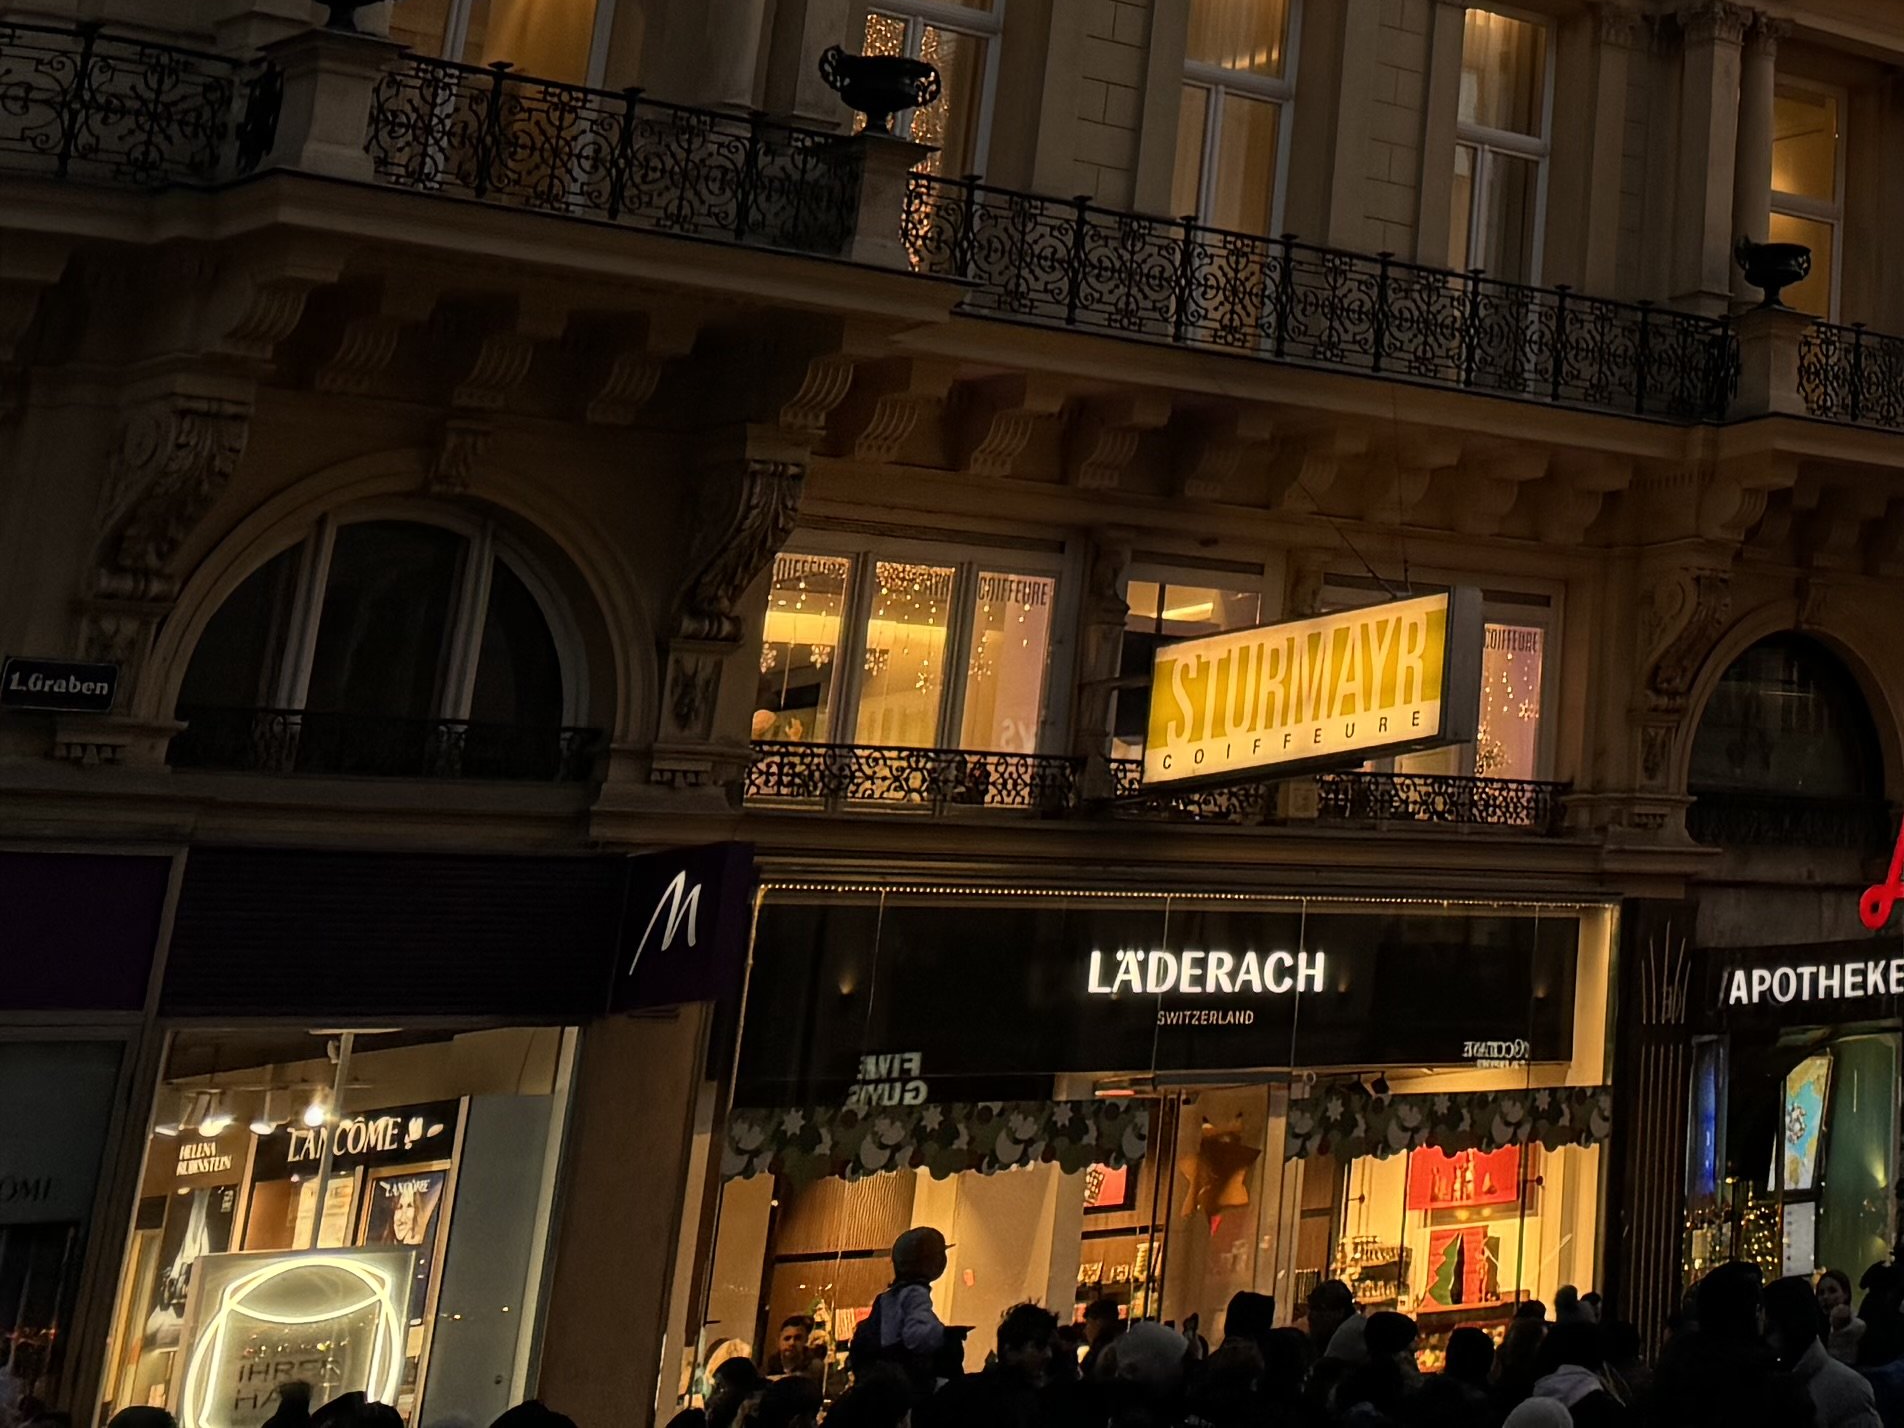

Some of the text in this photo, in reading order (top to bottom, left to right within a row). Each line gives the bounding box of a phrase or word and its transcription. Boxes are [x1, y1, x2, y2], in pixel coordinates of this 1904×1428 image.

[28, 672, 109, 695] Graben
[1167, 612, 1428, 744] STURMAYR
[1162, 710, 1420, 770] COIFFEURE
[1087, 949, 1326, 994] LÄDERACH
[1156, 1010, 1254, 1026] SWITZERLAND
[287, 1117, 402, 1163] LANCÔME
